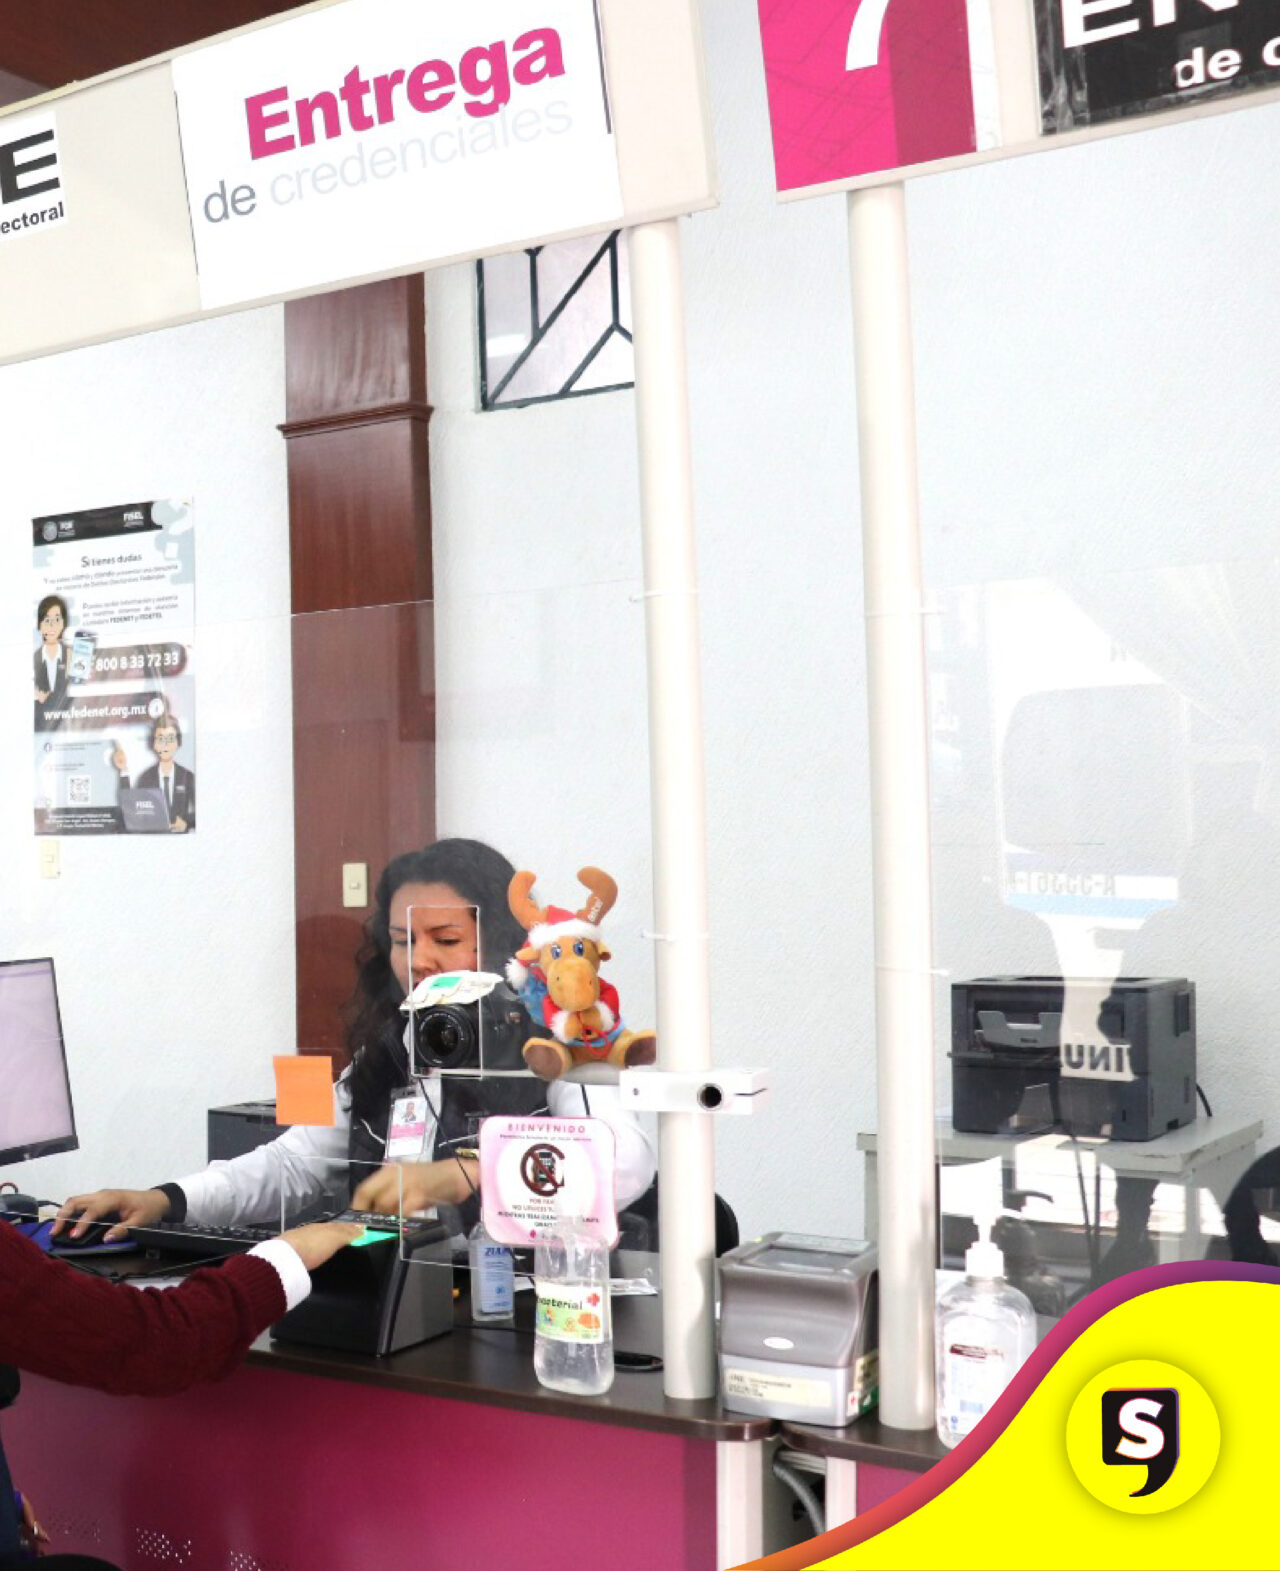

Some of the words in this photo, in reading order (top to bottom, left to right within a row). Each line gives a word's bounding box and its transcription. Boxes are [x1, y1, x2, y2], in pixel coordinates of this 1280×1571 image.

[1175, 46, 1241, 88] de
[245, 27, 566, 160] Entrega
[204, 180, 256, 224] de
[270, 99, 573, 206] credenciales
[96, 656, 117, 671] 800
[120, 656, 128, 669] 8
[130, 655, 145, 668] 33
[148, 653, 162, 667] 72
[163, 651, 179, 665] 33
[44, 704, 147, 721] www.fedenet.org.mx
[508, 1123, 586, 1133] BIENVENIDO
